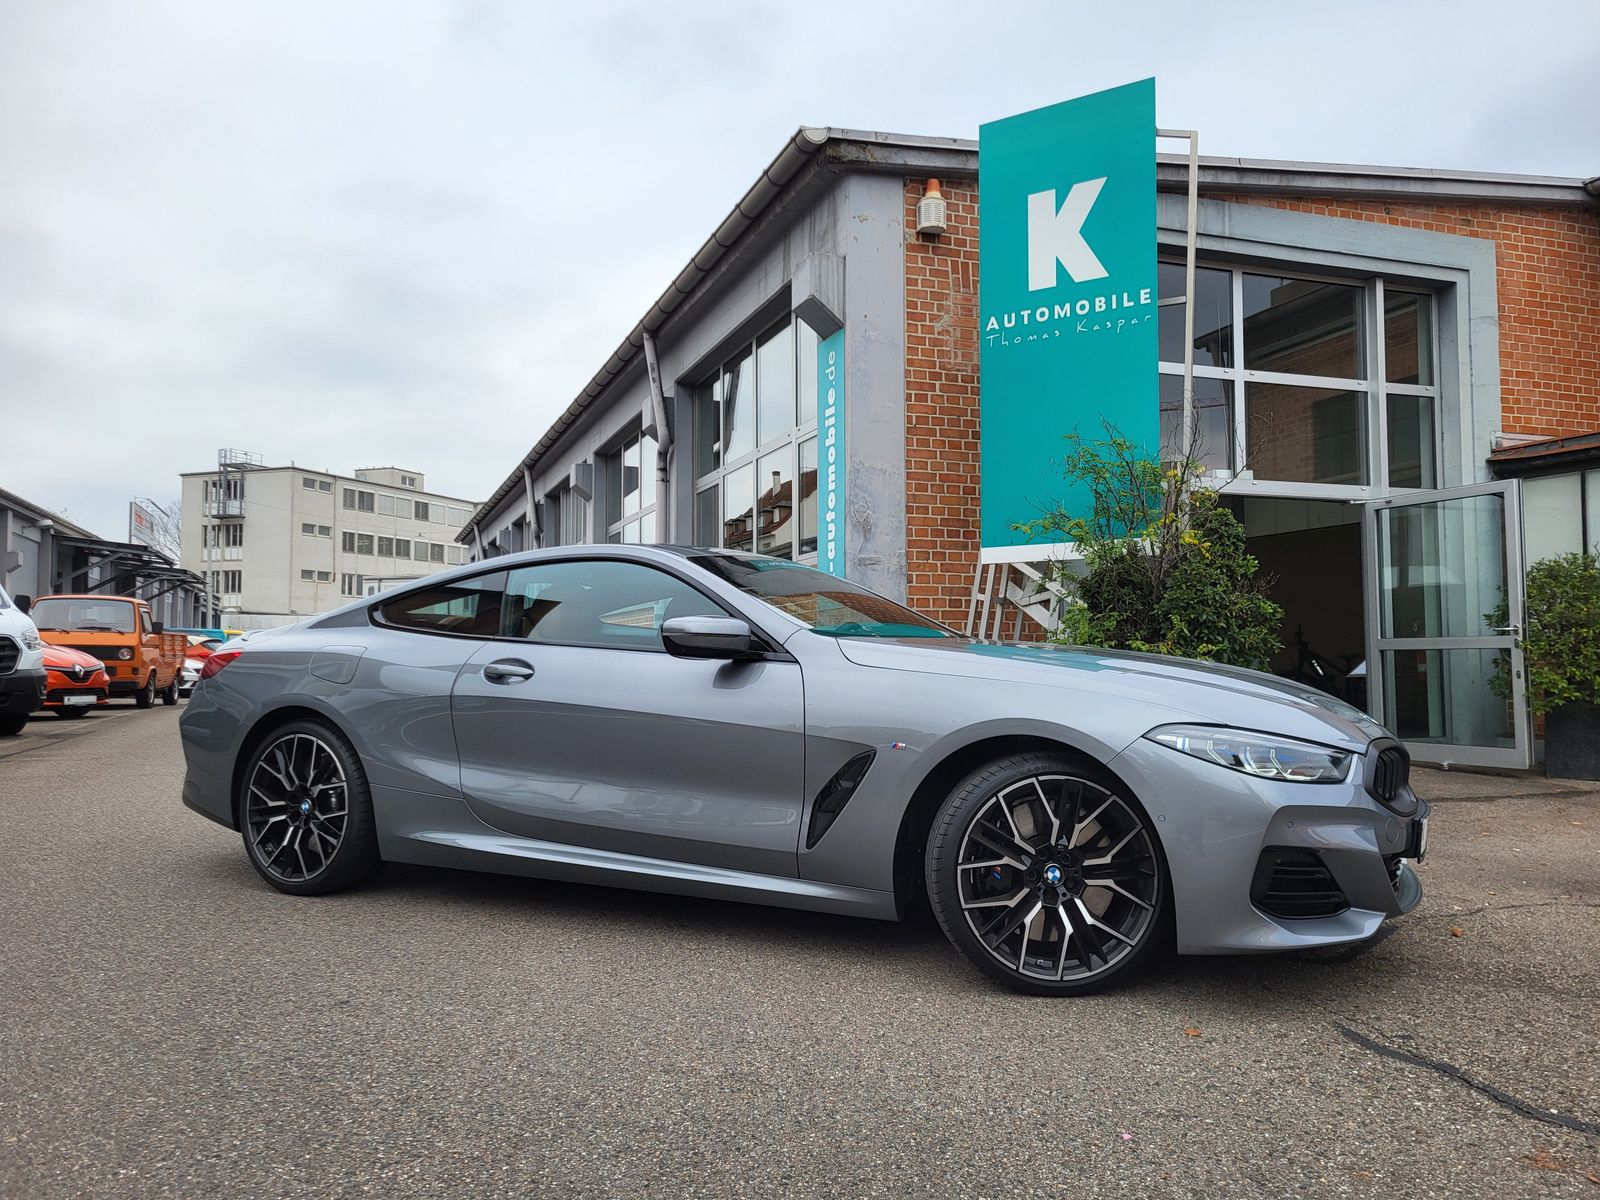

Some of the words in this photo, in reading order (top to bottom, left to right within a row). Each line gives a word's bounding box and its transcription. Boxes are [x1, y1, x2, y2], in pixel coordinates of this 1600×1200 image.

[1028, 177, 1109, 292] K
[986, 288, 1151, 331] AUTOMOBILE
[986, 330, 1060, 347] Thomas
[1076, 315, 1151, 334] Kaspar
[825, 351, 836, 577] -automobile.de
